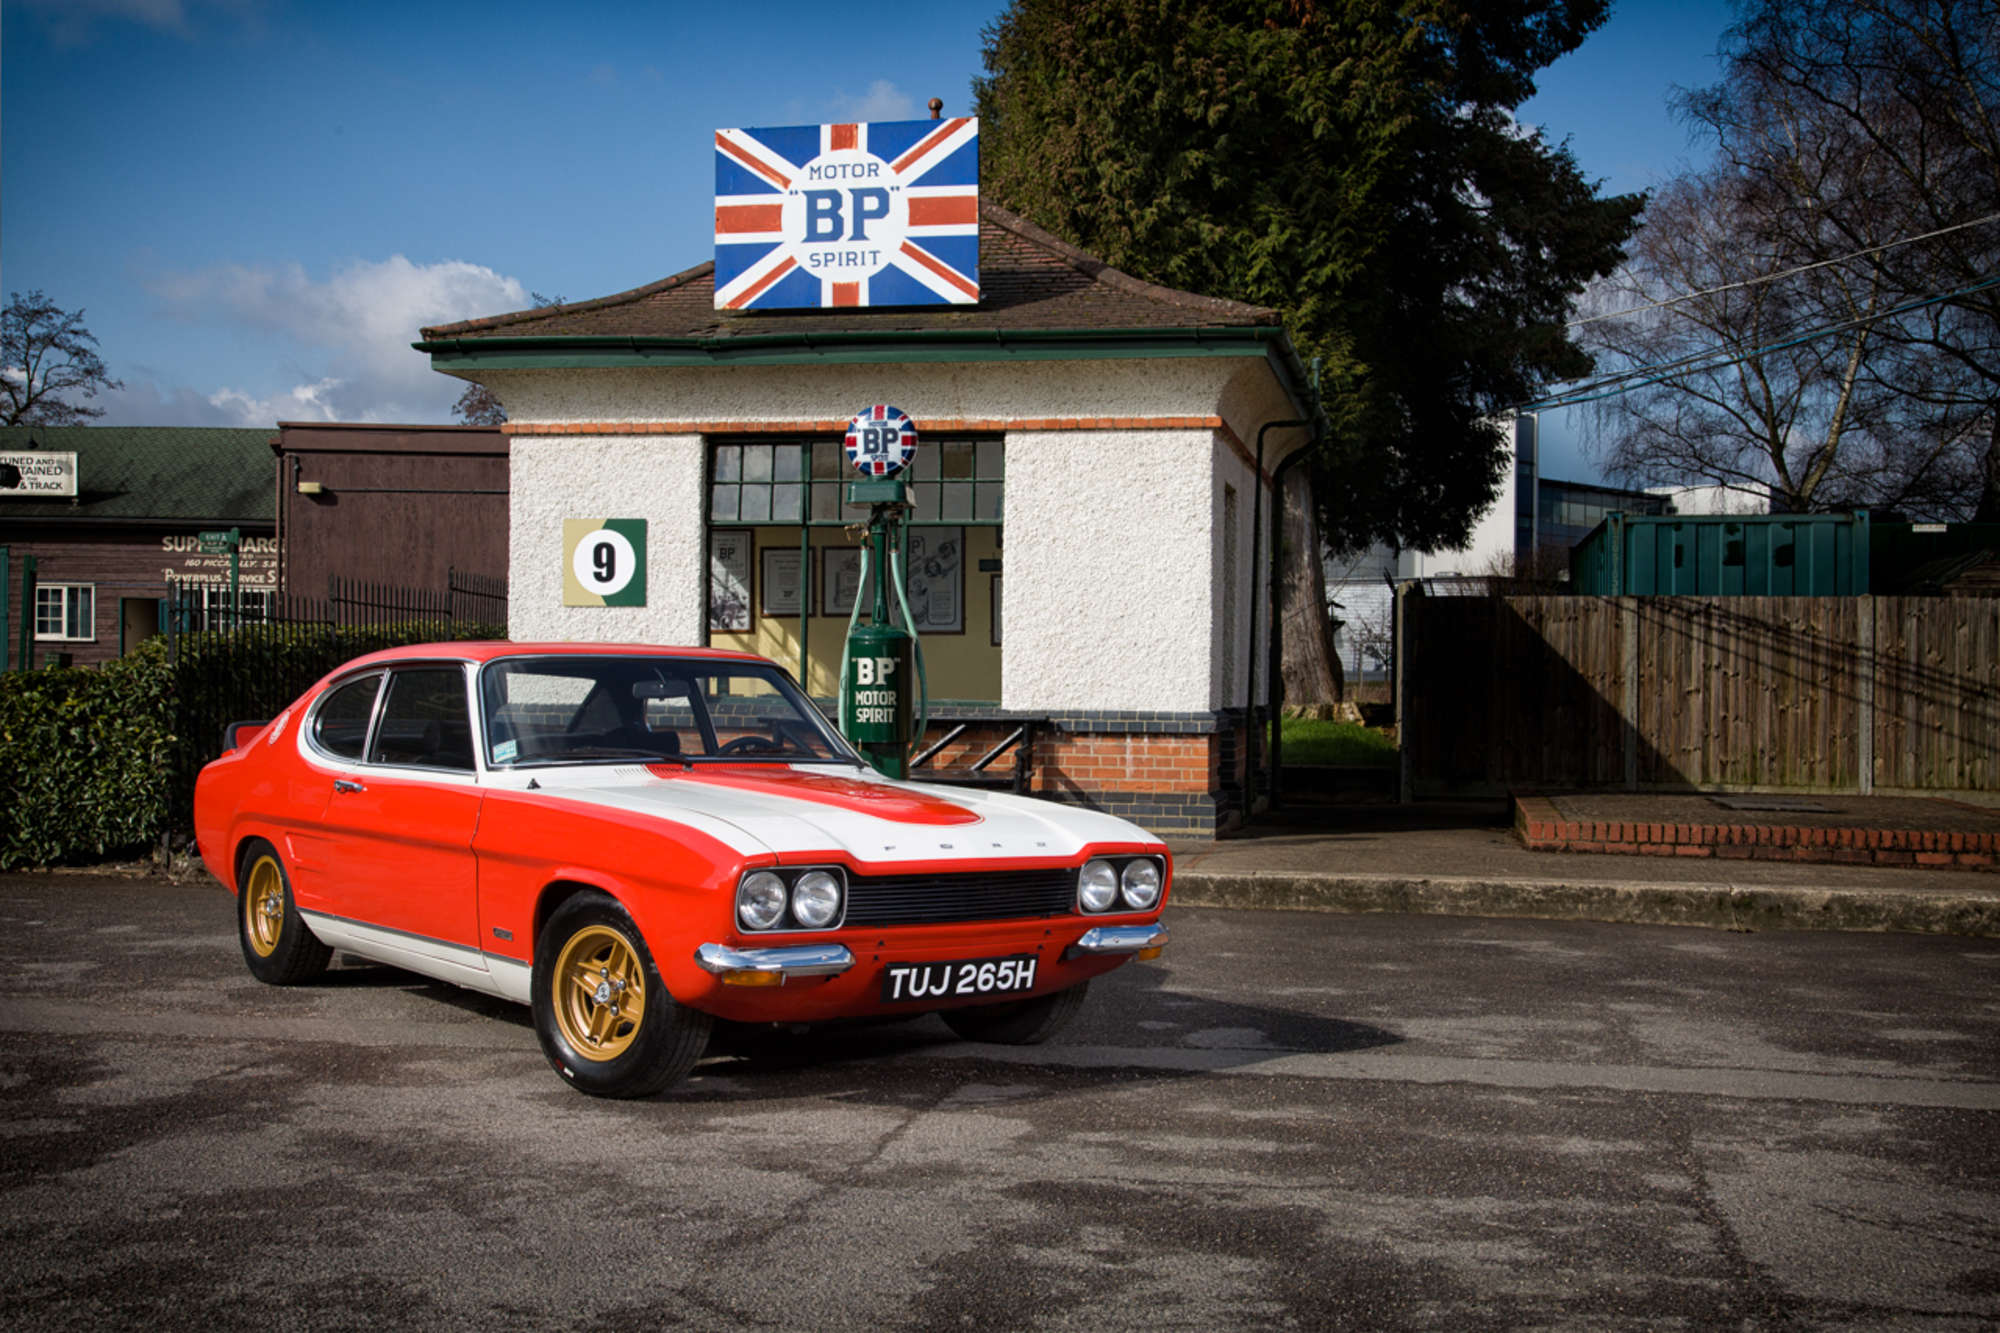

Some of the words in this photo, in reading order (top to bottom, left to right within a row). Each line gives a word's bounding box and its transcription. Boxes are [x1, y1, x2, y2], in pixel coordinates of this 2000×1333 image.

[809, 162, 880, 180] MOTOR
[809, 250, 881, 268] SPIRIT
[29, 481, 64, 490] TRACK
[593, 541, 616, 583] 9
[855, 690, 897, 706] MOTOR
[855, 707, 895, 723] SPIRIT
[889, 964, 952, 999] TUJ
[955, 959, 1036, 994] 265H
